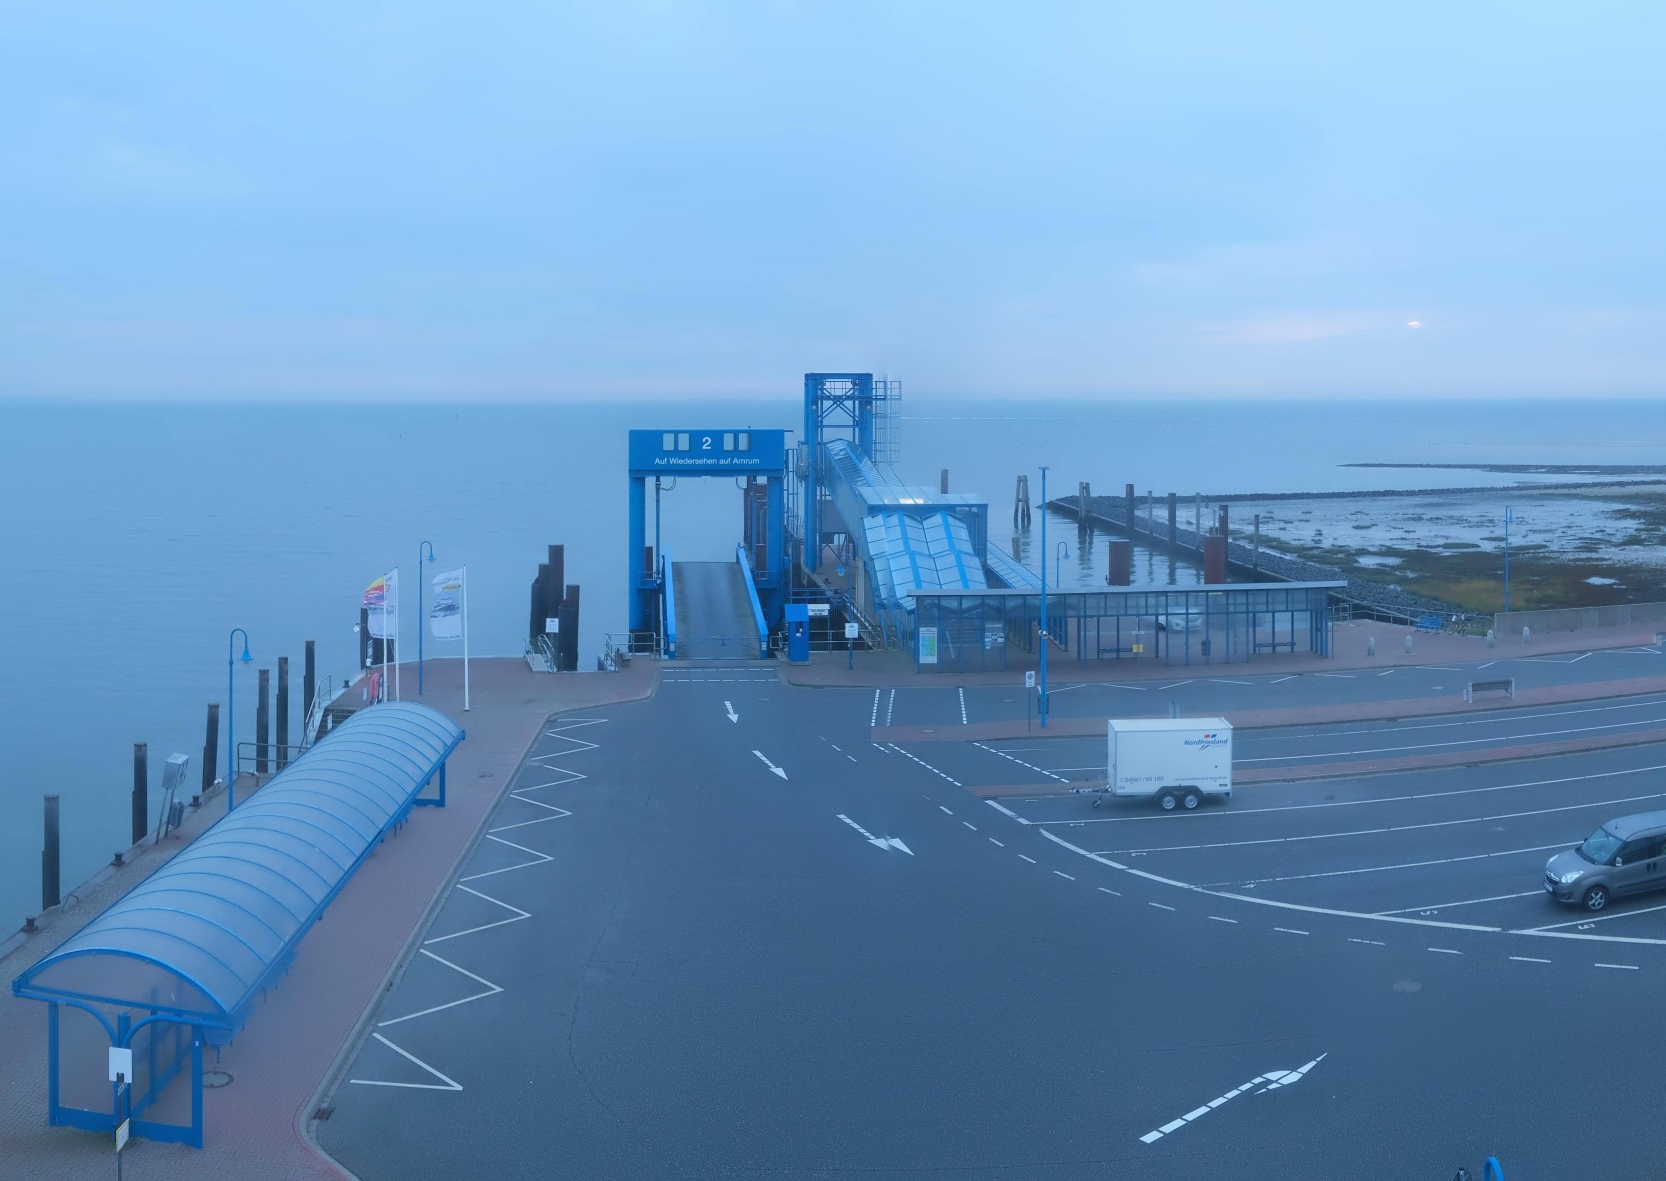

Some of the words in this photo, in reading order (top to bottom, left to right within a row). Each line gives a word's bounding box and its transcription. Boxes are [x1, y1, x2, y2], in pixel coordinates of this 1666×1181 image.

[702, 437, 712, 449] 2
[654, 457, 667, 465] Auf
[669, 457, 717, 465] Wiedersehen
[719, 457, 731, 465] auf
[733, 457, 760, 465] Amrum
